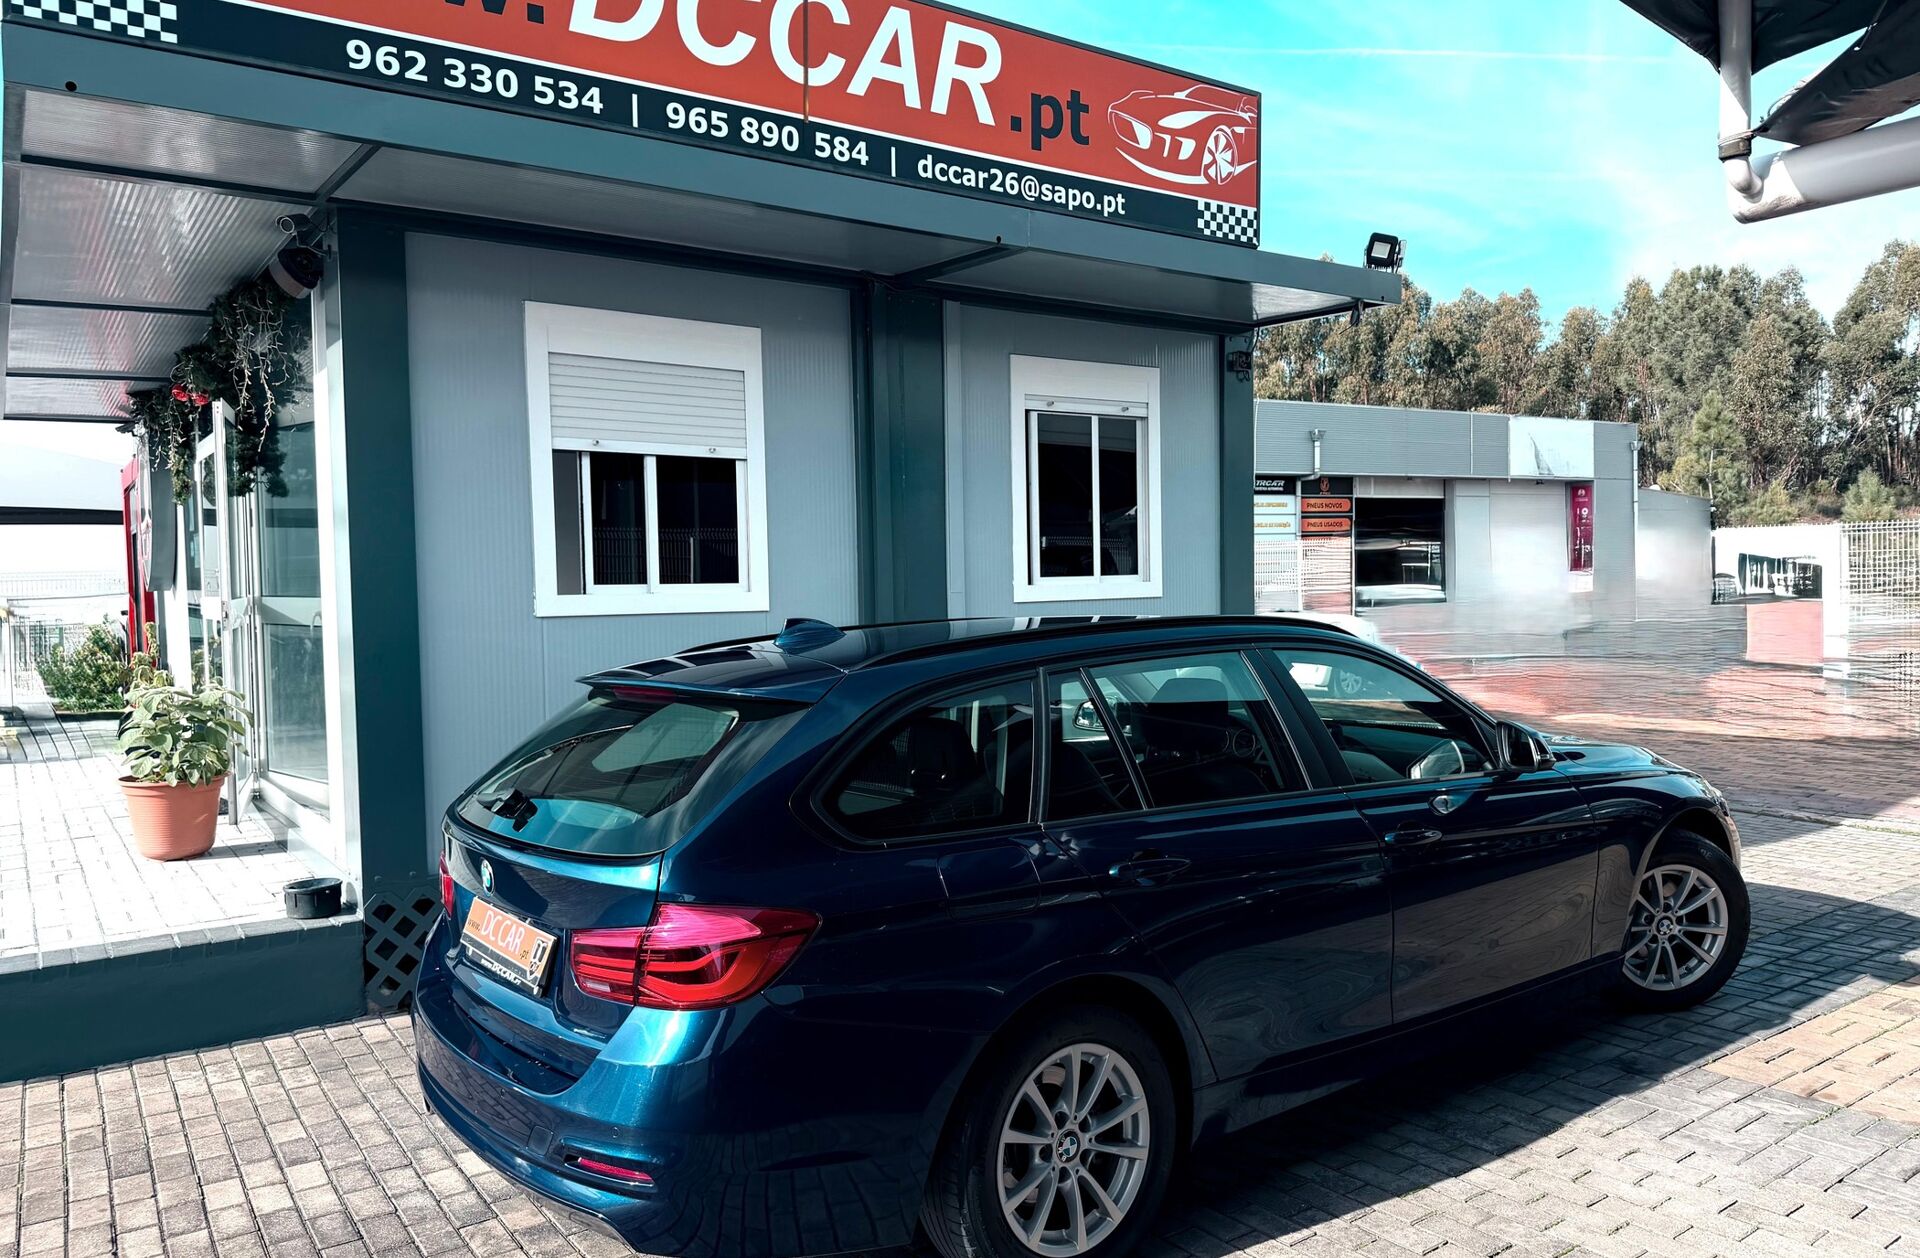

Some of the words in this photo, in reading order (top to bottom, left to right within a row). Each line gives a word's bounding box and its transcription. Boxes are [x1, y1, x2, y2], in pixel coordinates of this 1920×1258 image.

[346, 39, 428, 82] 962
[443, 58, 519, 98] 330
[534, 75, 604, 115] 534
[666, 102, 729, 138] 965
[740, 116, 799, 152] 890
[815, 131, 869, 166] 584
[917, 154, 1126, 217] dccar26@sapo.pt
